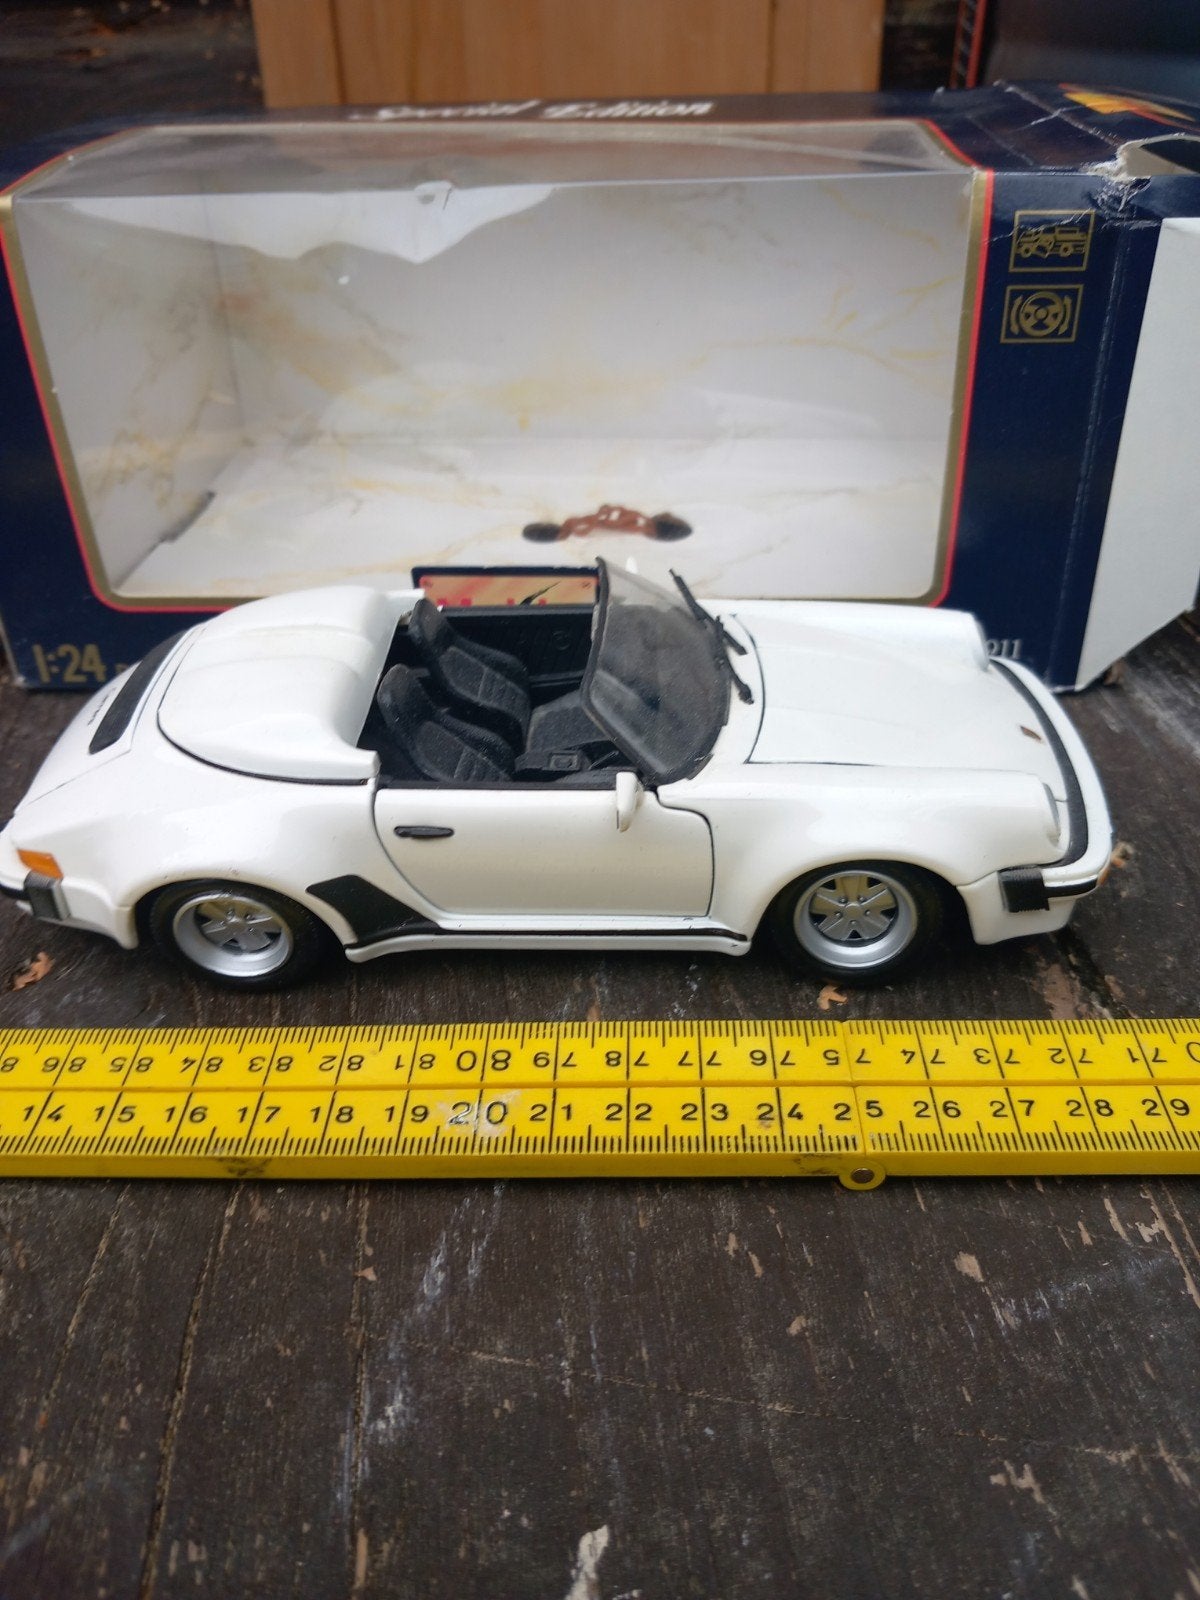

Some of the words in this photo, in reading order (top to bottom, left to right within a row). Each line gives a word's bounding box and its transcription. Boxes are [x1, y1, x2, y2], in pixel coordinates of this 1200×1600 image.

[32, 644, 107, 684] 1:24
[318, 1055, 366, 1072] 82
[393, 1053, 436, 1071] 81
[456, 1050, 512, 1072] 80
[532, 1051, 578, 1069] 79
[604, 1050, 650, 1068] 78
[677, 1050, 722, 1067] 77
[749, 1049, 796, 1067] 76
[823, 1048, 871, 1066] 75
[900, 1048, 946, 1065] 74
[972, 1048, 1021, 1065] 73
[1046, 1048, 1093, 1065] 72
[1127, 1047, 1168, 1063] 71
[41, 1056, 87, 1073] 86
[109, 1057, 154, 1073] 85
[180, 1056, 224, 1073] 84
[247, 1056, 294, 1073] 83
[23, 1104, 66, 1122] 14
[93, 1105, 137, 1123] 15
[164, 1105, 209, 1124] 16
[237, 1105, 282, 1123] 17
[309, 1105, 355, 1124] 18
[384, 1104, 430, 1123] 19
[448, 1101, 509, 1126] 20
[528, 1104, 574, 1122] 21
[604, 1103, 653, 1122] 22
[681, 1103, 729, 1121] 23
[756, 1103, 804, 1121] 24
[832, 1101, 884, 1121] 25
[913, 1101, 962, 1118] 26
[990, 1100, 1036, 1118] 27
[1065, 1099, 1115, 1117] 28
[1141, 1098, 1190, 1116] 29
